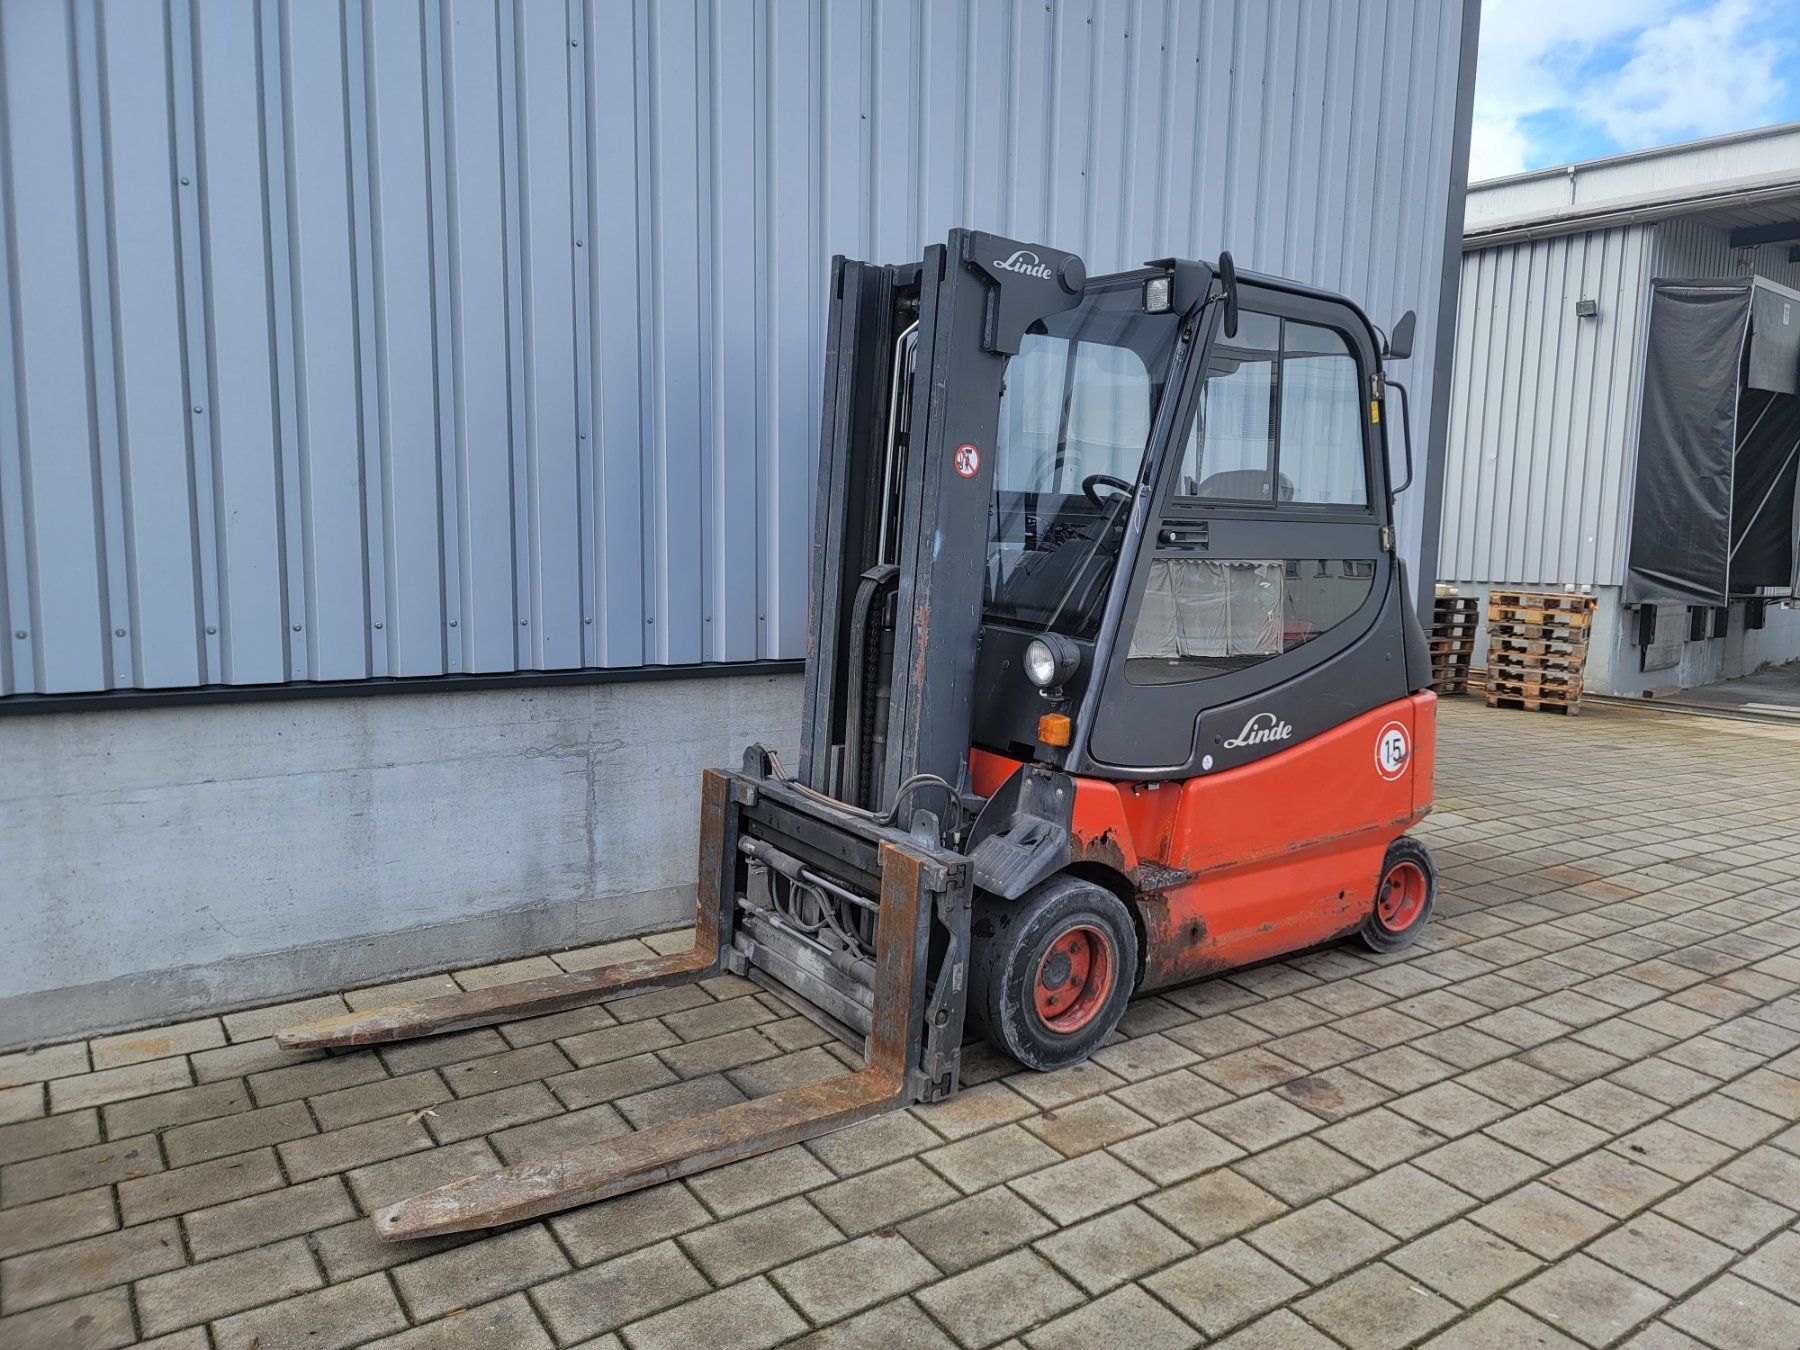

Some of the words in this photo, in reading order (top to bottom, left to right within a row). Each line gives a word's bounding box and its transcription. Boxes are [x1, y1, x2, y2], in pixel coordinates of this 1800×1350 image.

[993, 250, 1052, 279] Linde
[1223, 712, 1292, 748] Linde
[1385, 738, 1402, 764] 15
